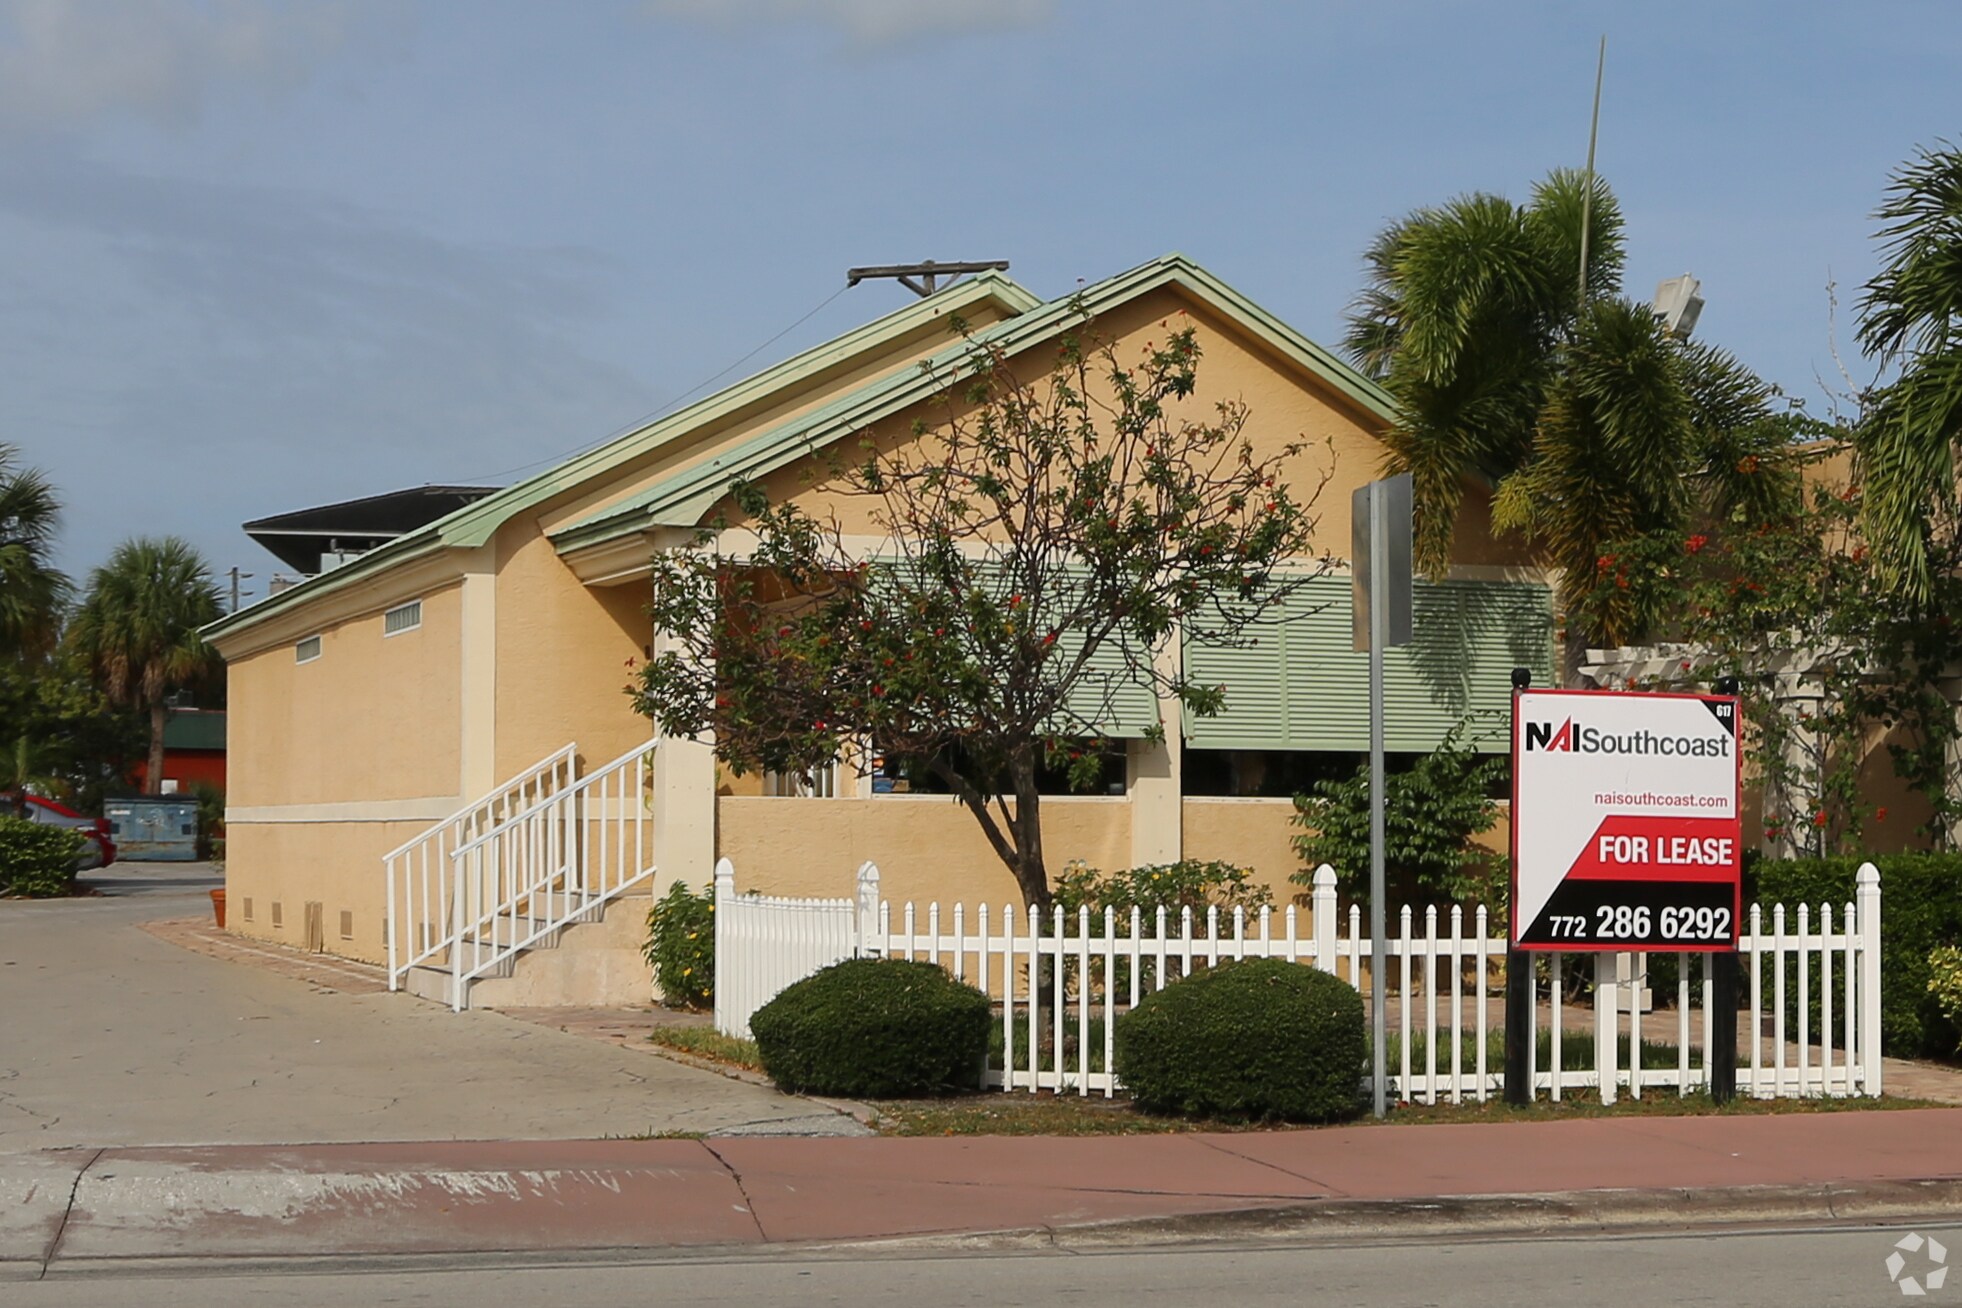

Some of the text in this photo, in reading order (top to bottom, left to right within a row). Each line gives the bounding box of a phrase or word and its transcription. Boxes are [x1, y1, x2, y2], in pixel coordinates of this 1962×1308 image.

[1594, 791, 1728, 807] naisouthcoast.com
[1600, 835, 1732, 865] FOR LEASE
[1549, 906, 1730, 939] 772 286 6292
